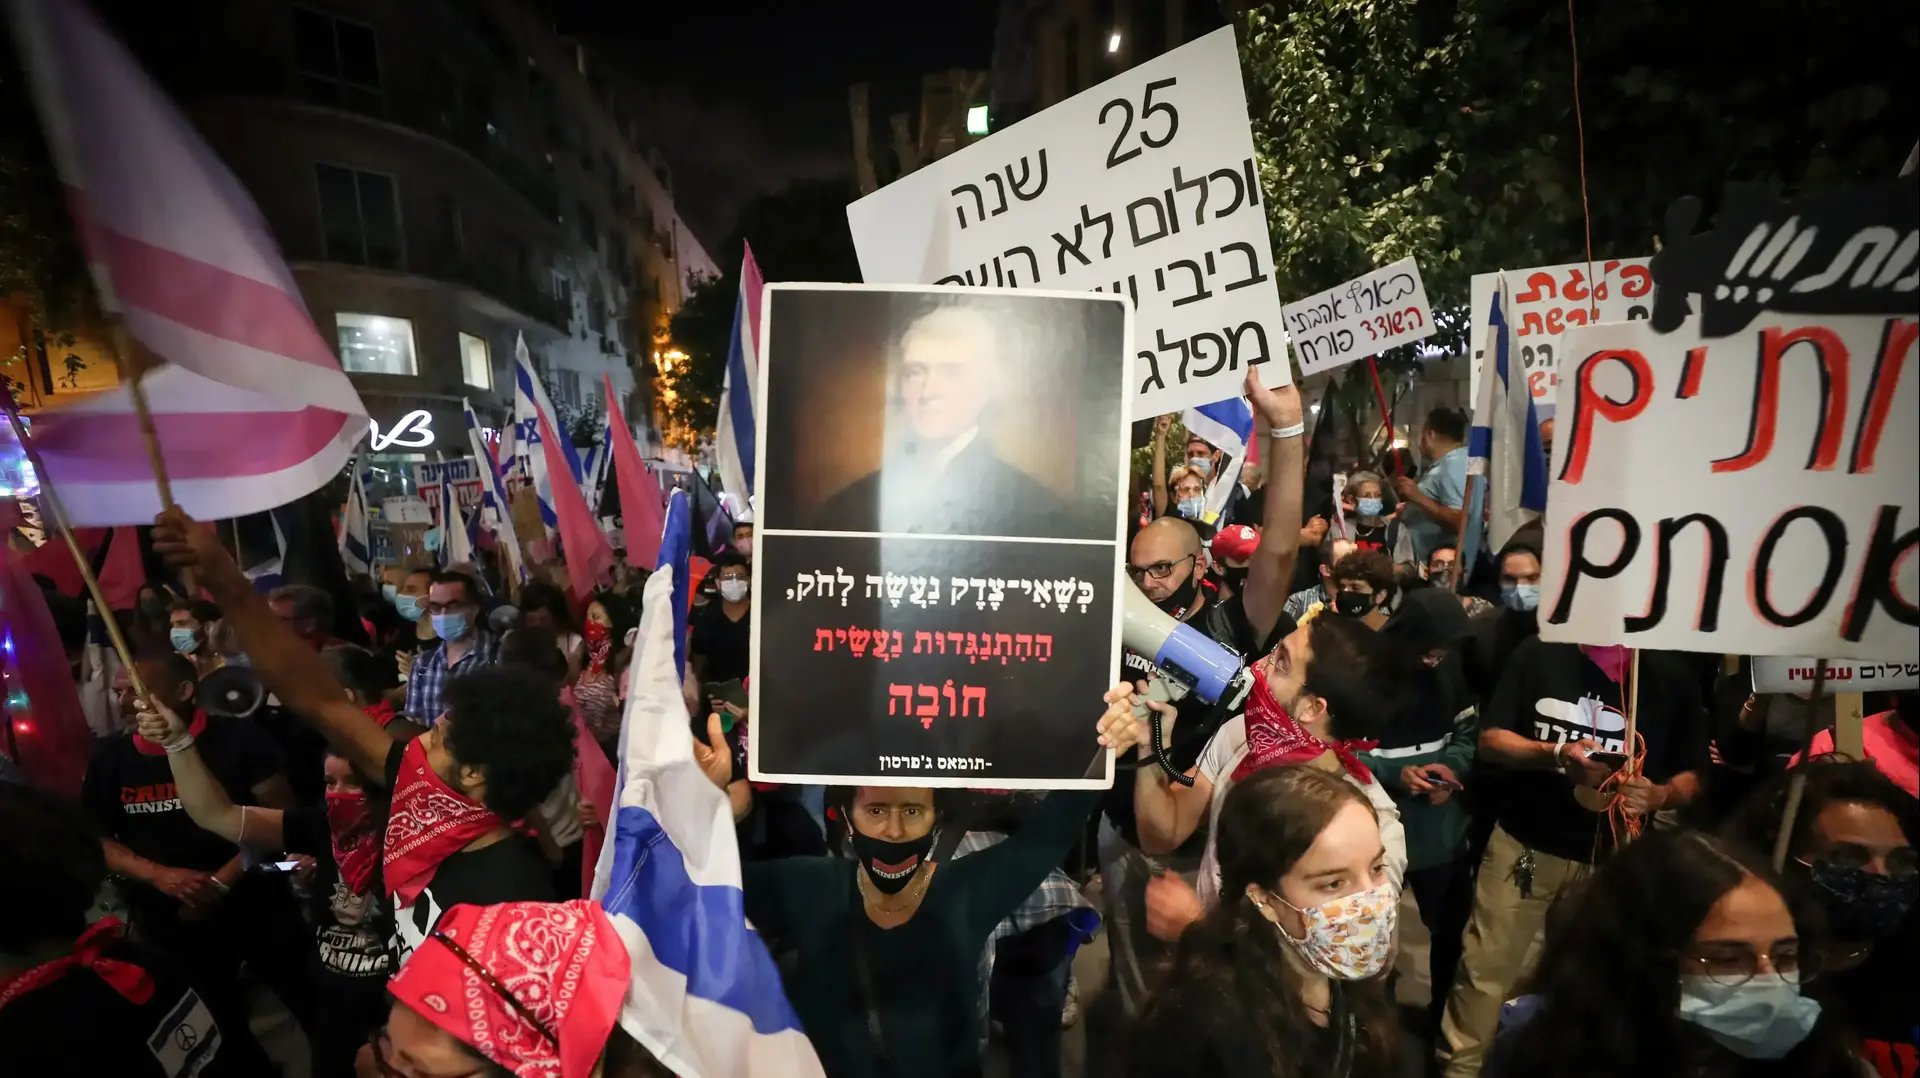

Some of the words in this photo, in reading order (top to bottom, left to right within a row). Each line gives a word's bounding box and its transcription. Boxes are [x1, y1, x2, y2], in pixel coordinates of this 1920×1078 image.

[1098, 77, 1179, 169] 25
[951, 148, 1048, 229] שנה
[1126, 158, 1259, 248] וכלום
[1051, 204, 1113, 275] לא
[1156, 241, 1268, 308] ביבי
[1516, 260, 1653, 304] פלגת
[1291, 293, 1347, 335] אהבתי
[1360, 306, 1423, 340] השודד
[1137, 321, 1271, 394] מפלג
[1300, 329, 1354, 364] פורח
[1860, 662, 1919, 679] שלום
[124, 798, 183, 814] MINIST
